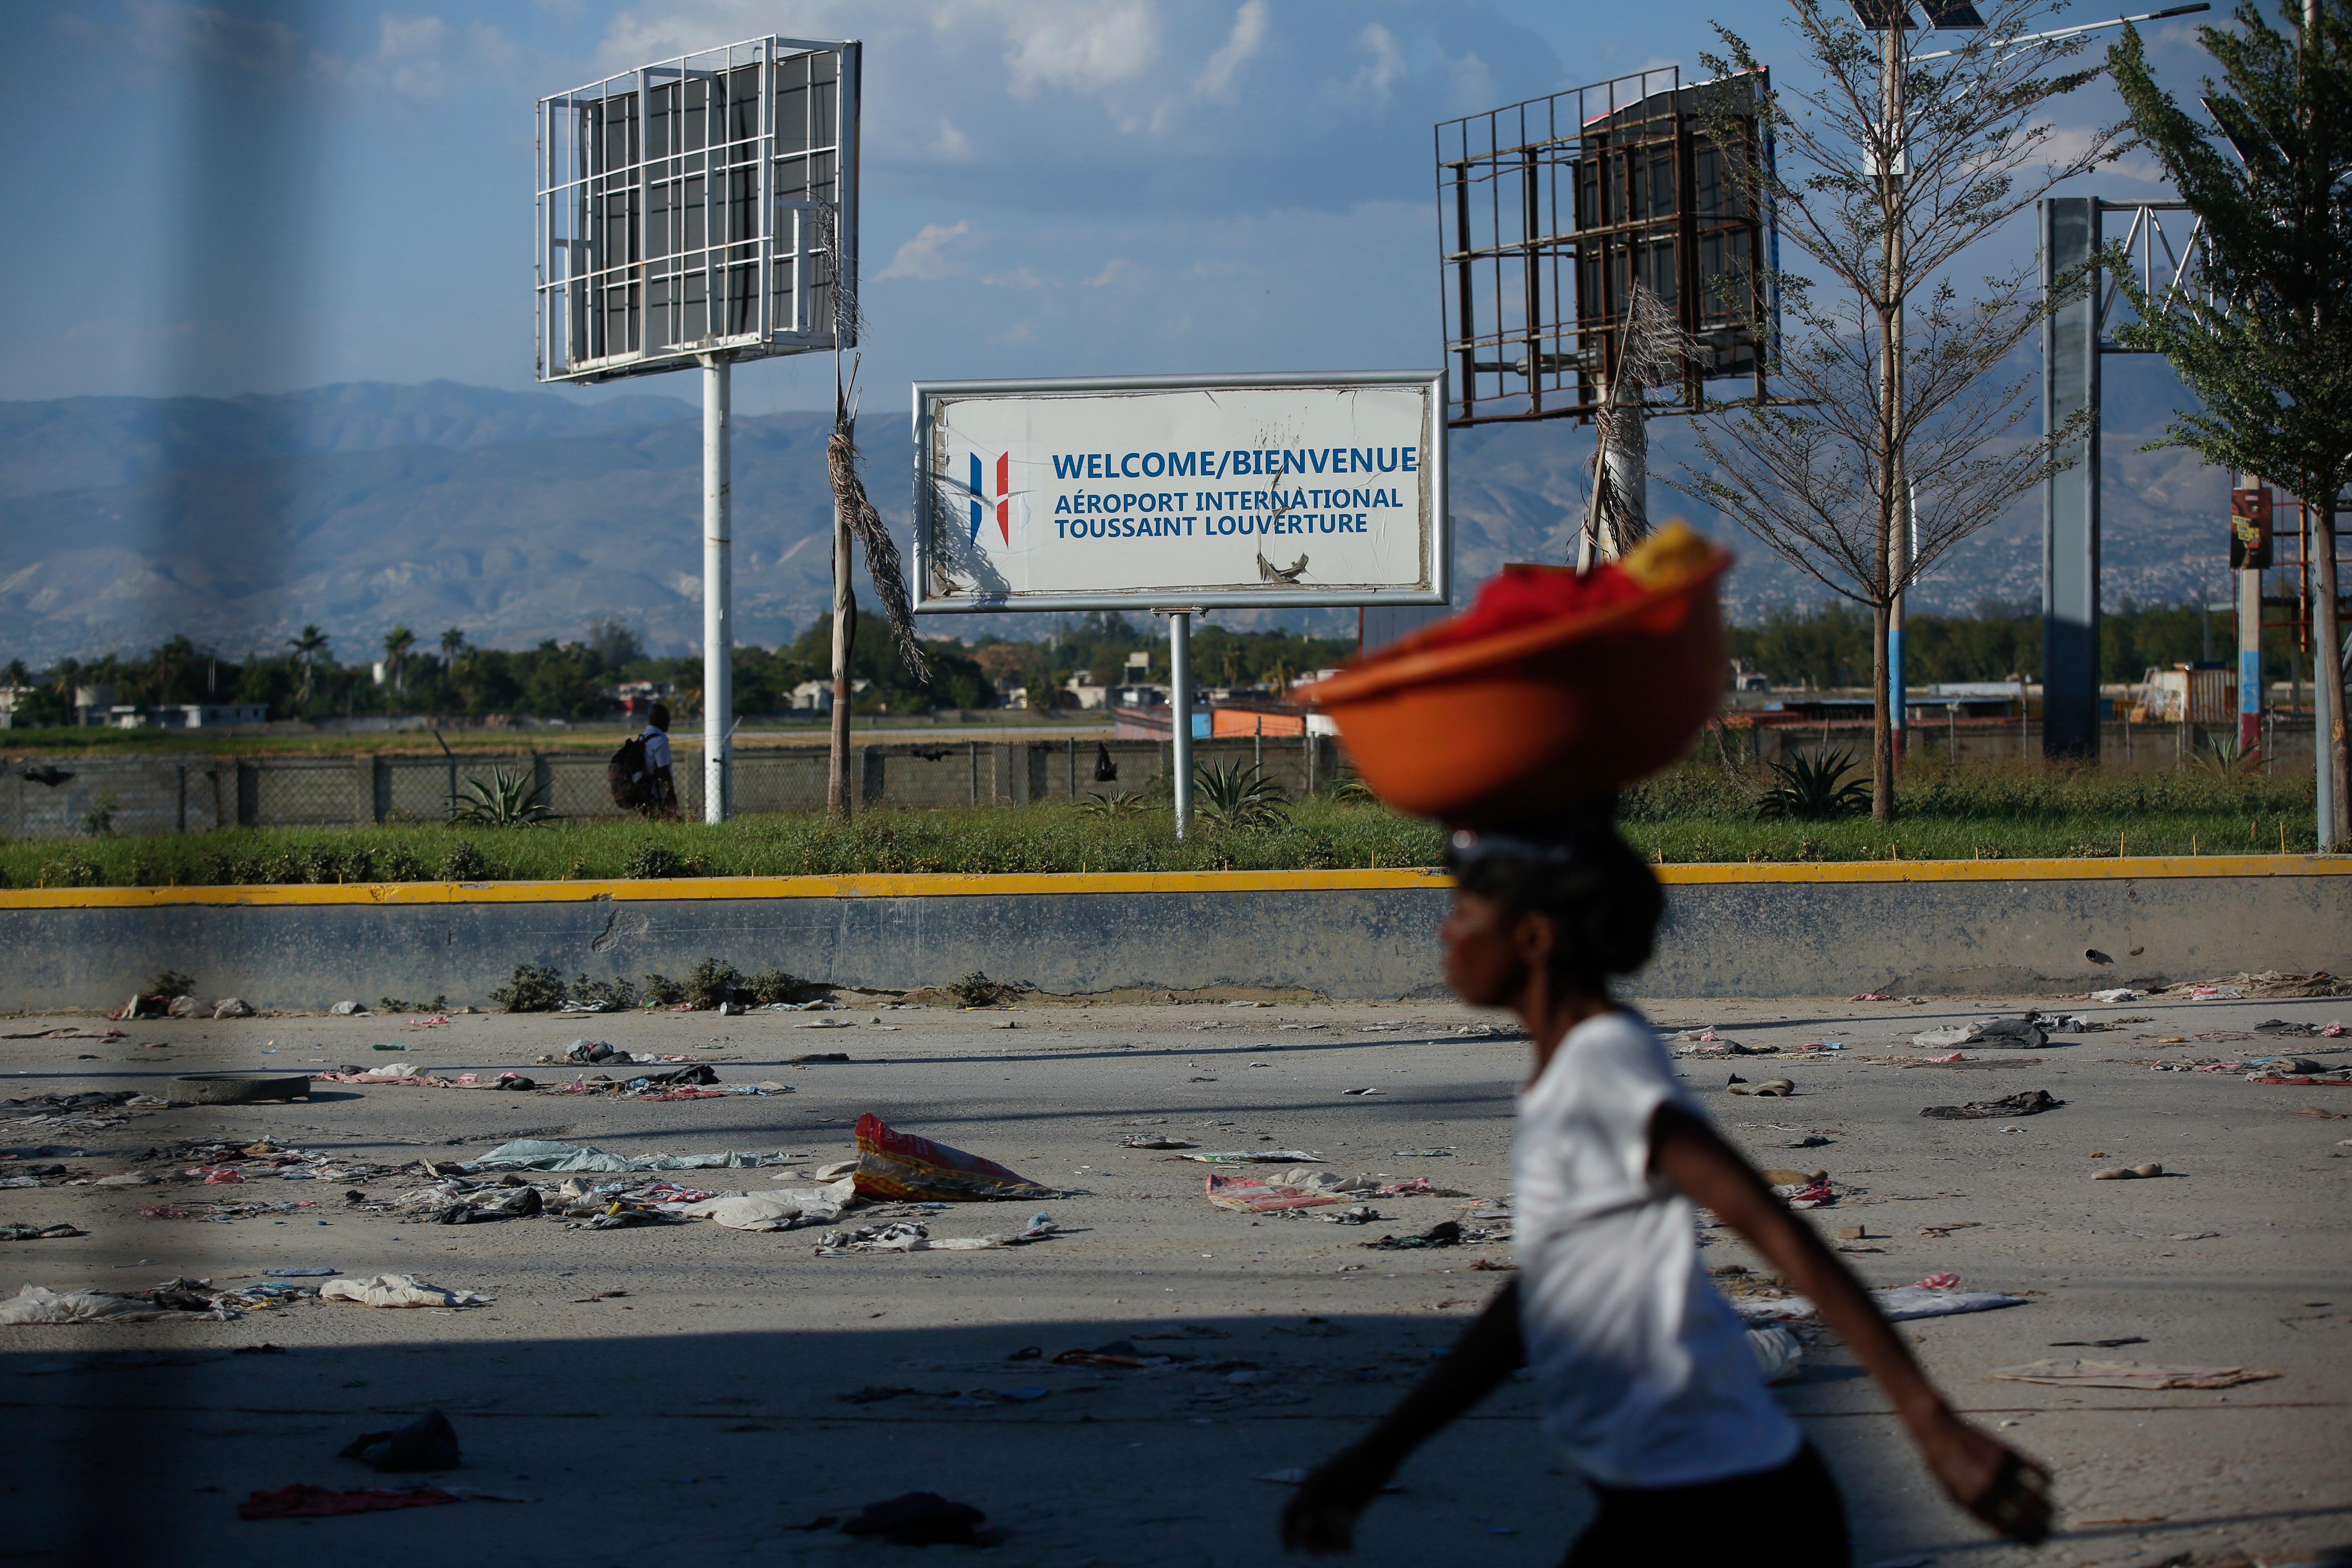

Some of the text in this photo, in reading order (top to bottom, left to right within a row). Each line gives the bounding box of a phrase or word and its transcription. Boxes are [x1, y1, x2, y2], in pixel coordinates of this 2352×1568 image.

[1052, 447, 1417, 479] WELCOME/BIENVENUE
[1055, 488, 1403, 514] AÉROPORT INTERNATIONAL
[1055, 513, 1368, 539] TOUSSAINT LOUVERTURE
